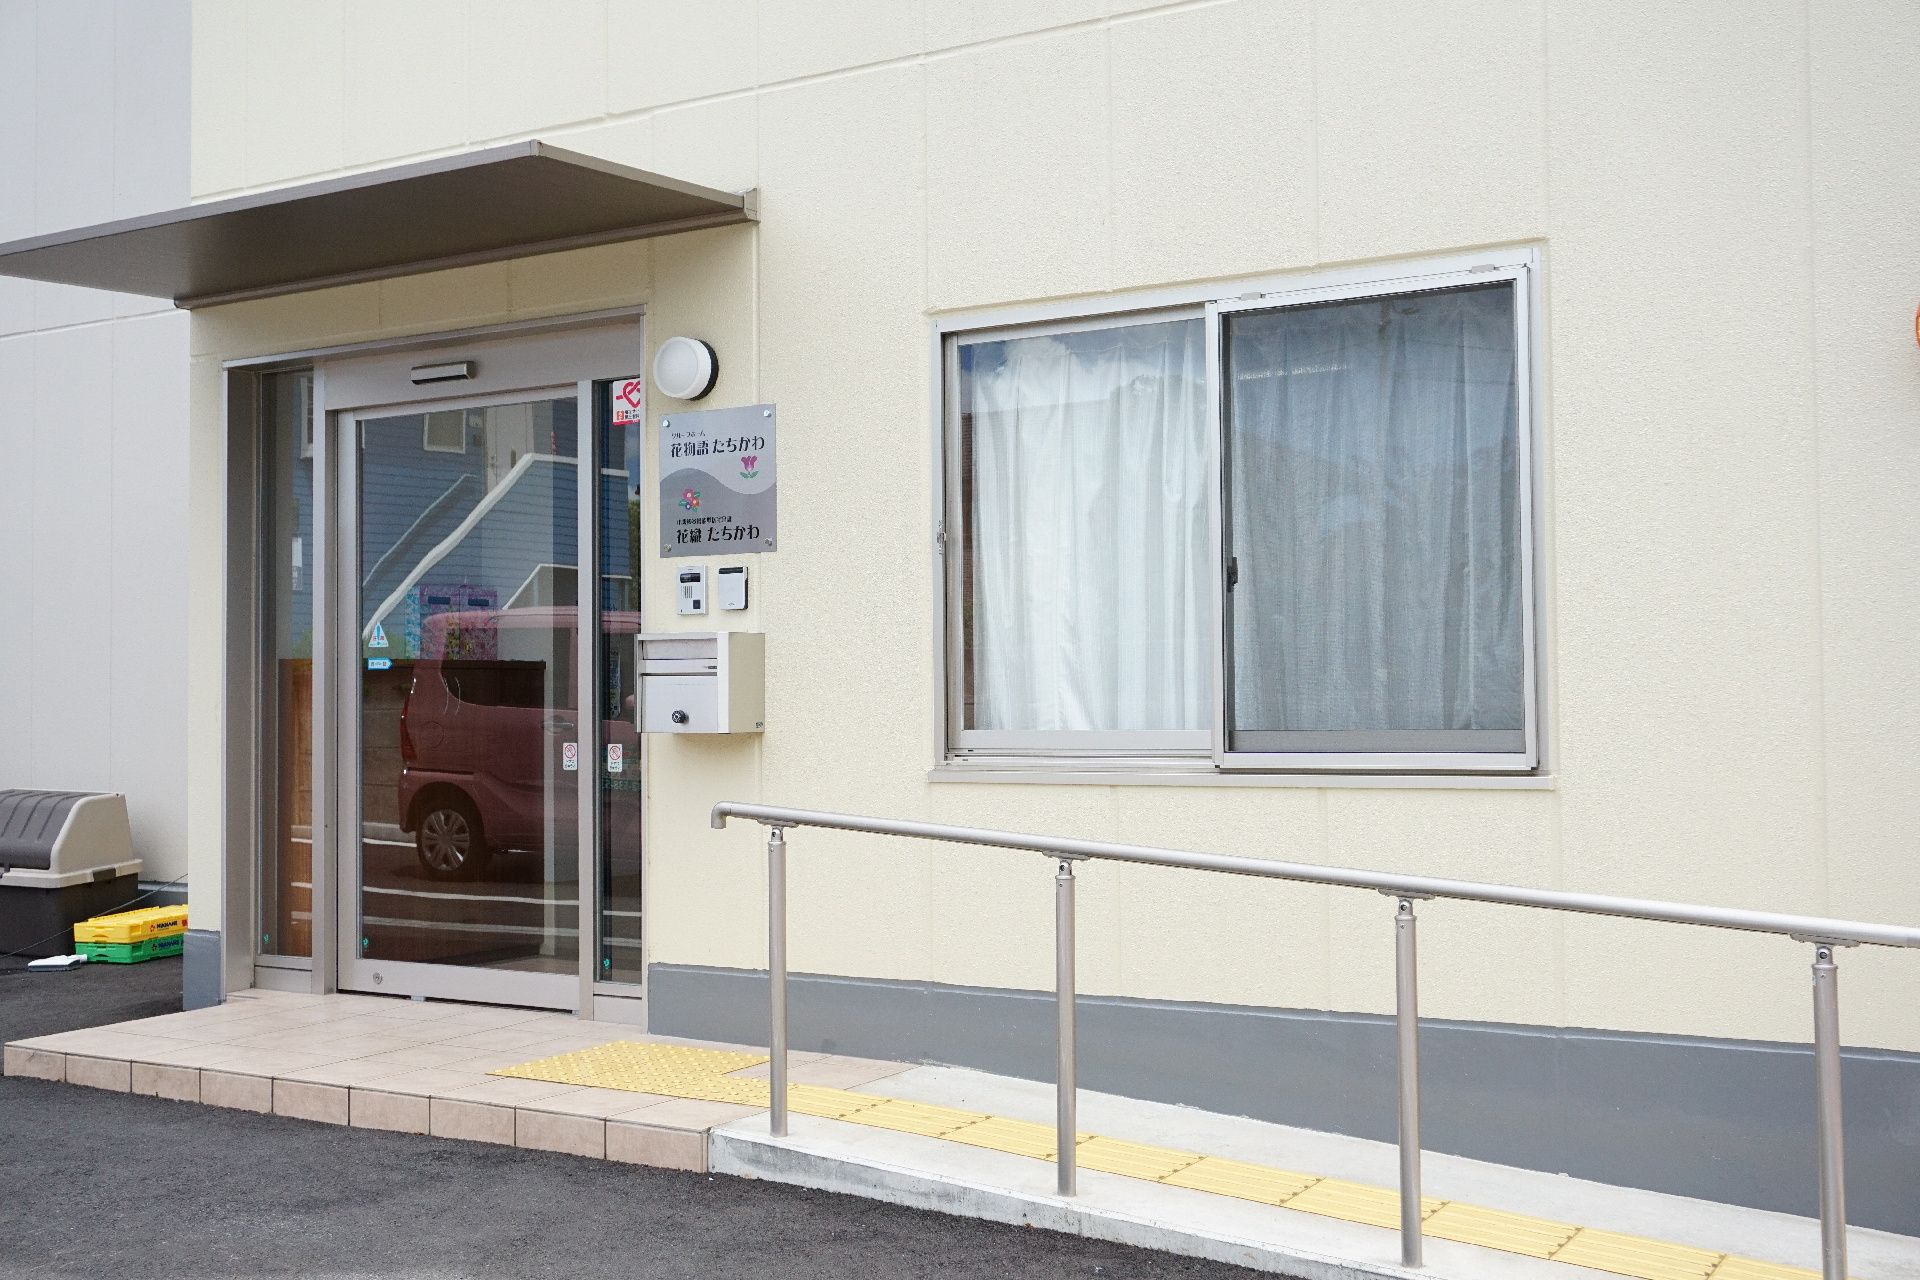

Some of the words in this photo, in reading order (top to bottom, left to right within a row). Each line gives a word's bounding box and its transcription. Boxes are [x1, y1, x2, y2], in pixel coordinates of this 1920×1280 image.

[671, 440, 709, 458] 花物語
[713, 436, 765, 454] たちかわ
[707, 525, 760, 542] たちかわ
